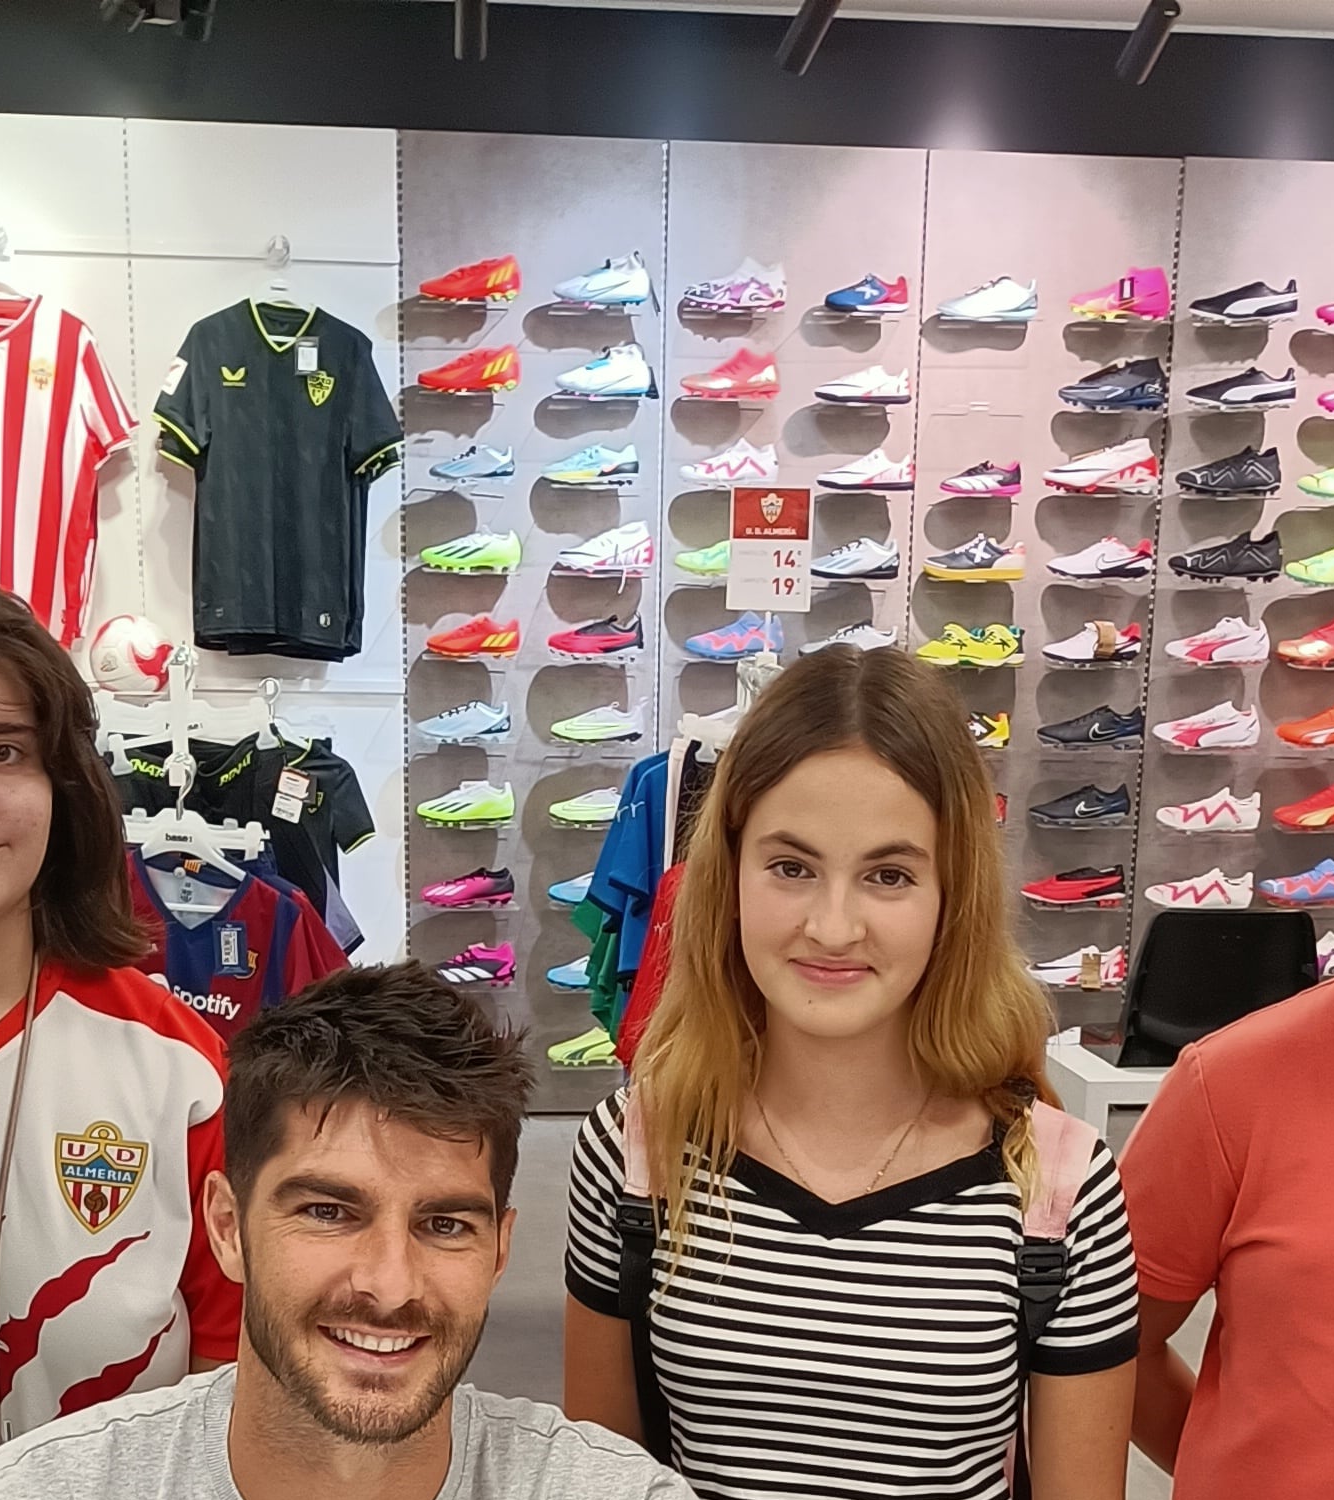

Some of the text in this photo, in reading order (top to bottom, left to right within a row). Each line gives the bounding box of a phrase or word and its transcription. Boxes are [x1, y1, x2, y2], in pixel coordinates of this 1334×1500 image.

[773, 550, 796, 568] 14
[772, 577, 795, 595] 19
[67, 1142, 136, 1163] U D
[64, 1165, 133, 1183] ALMERIA
